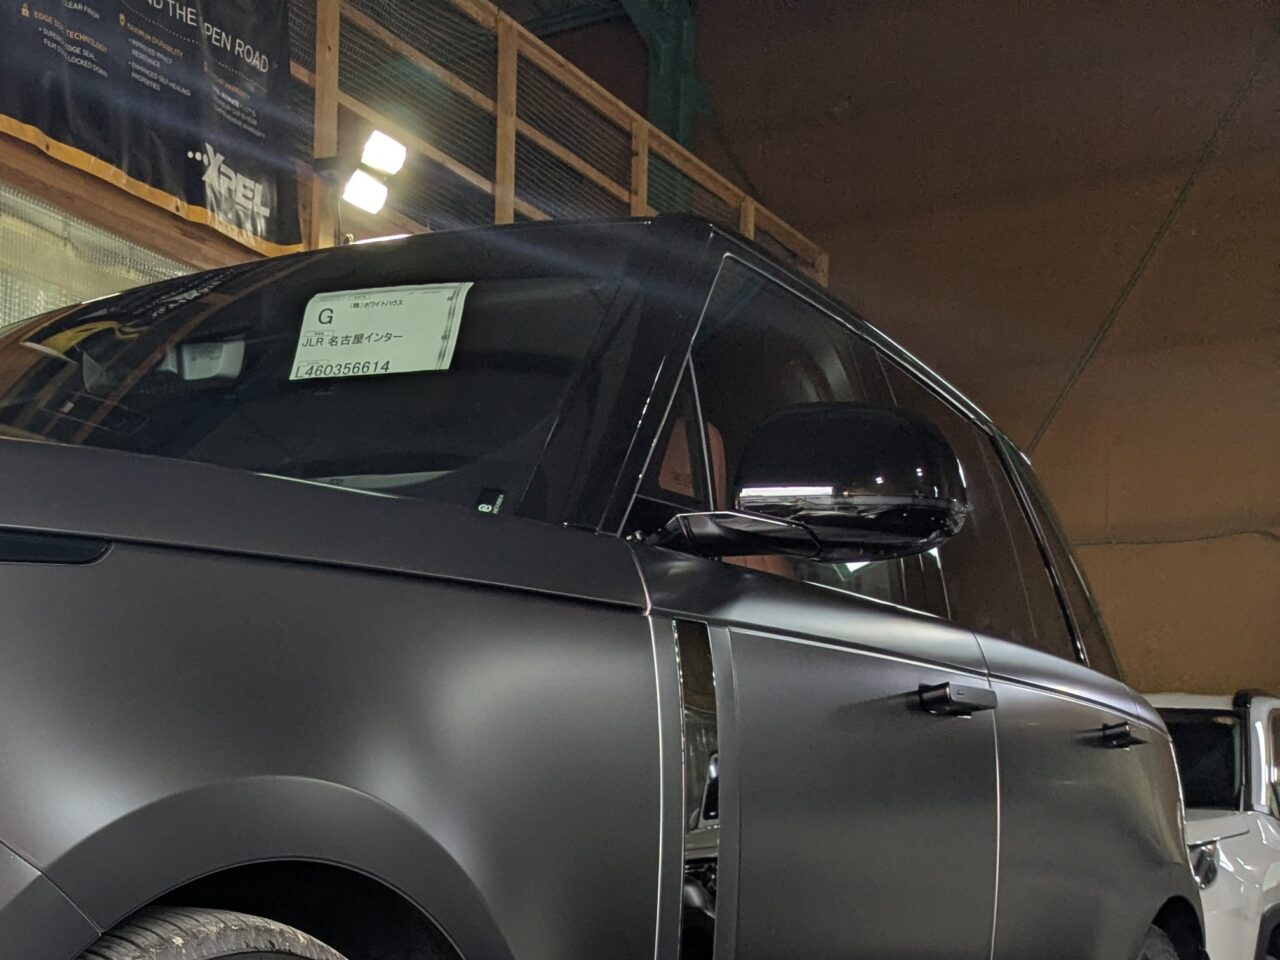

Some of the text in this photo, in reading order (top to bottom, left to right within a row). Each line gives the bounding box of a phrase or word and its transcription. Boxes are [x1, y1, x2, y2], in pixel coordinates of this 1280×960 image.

[203, 22, 232, 52] PEN
[234, 38, 269, 73] ROAD
[318, 307, 334, 325] G
[301, 332, 403, 348] JLR 名古屋インター
